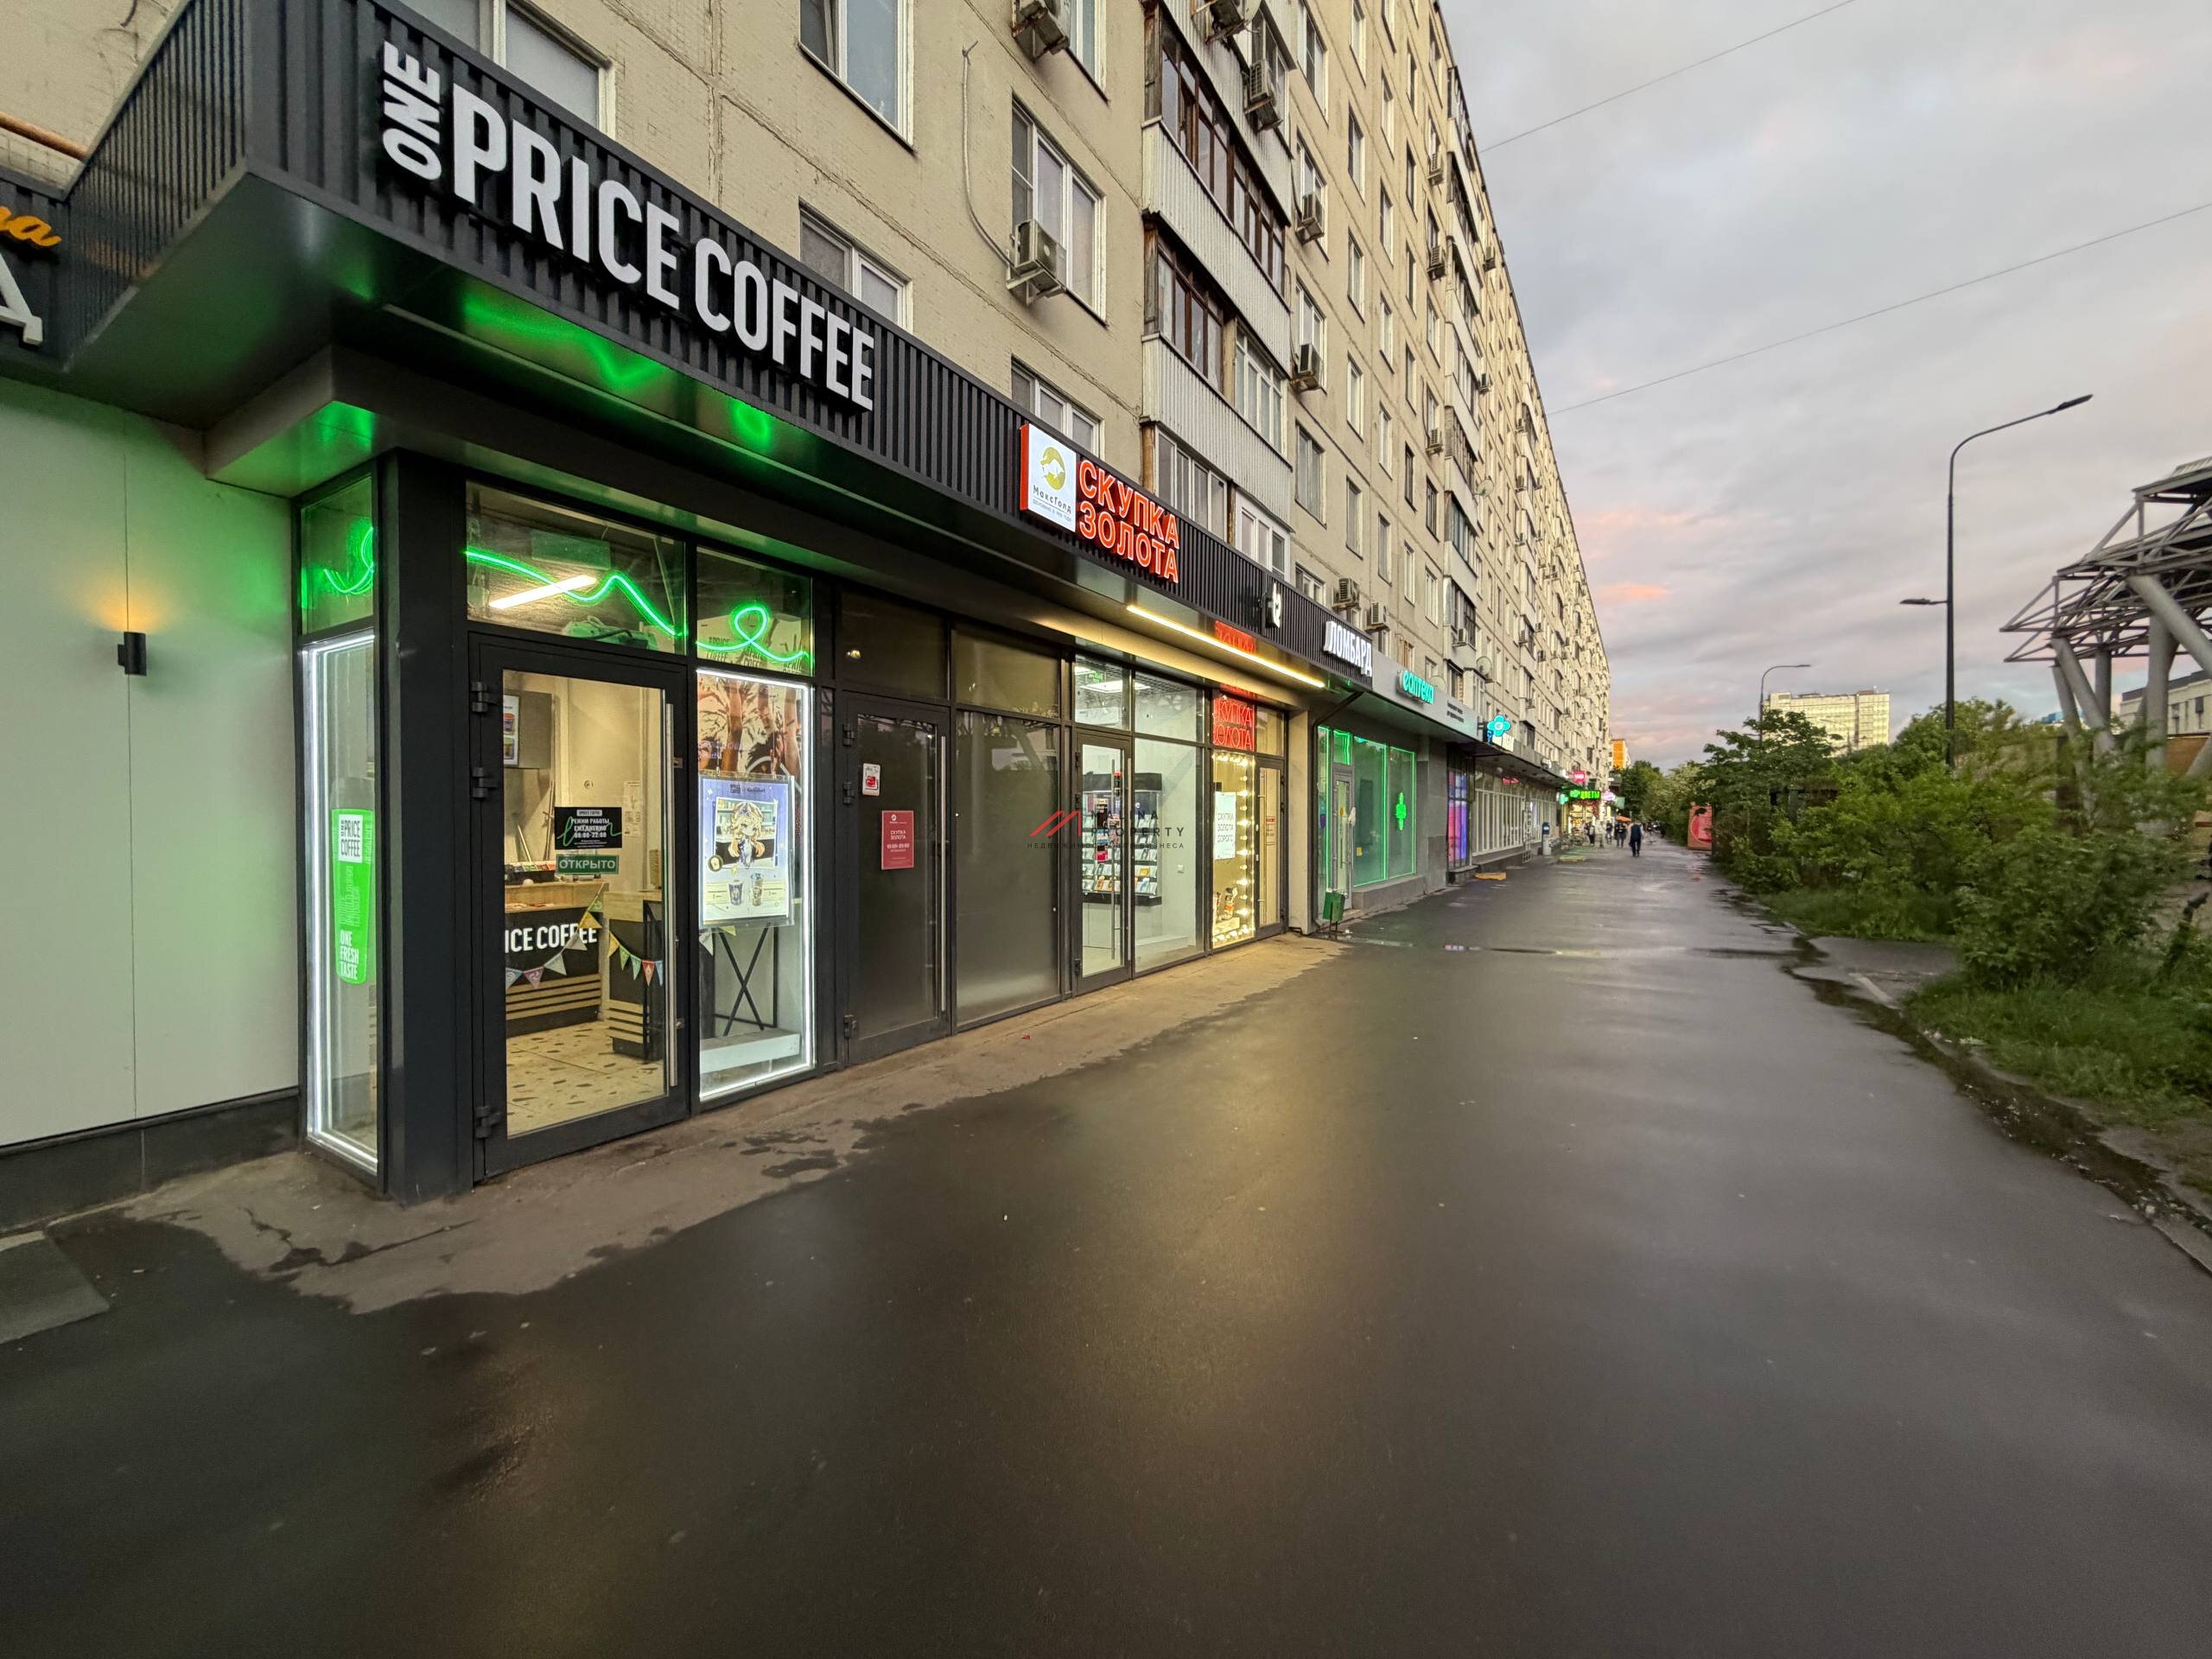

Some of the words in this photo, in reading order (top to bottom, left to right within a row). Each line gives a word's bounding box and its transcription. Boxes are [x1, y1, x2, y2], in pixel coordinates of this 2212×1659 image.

[383, 41, 442, 181] ONE
[453, 83, 680, 310] PRICE
[695, 238, 874, 411] COFFEE
[1033, 484, 1071, 514] МаксГолд
[1079, 460, 1179, 550] СКУПКА
[1079, 500, 1179, 583] ЗОЛОТА
[1324, 620, 1372, 677] ЛОМБАРД
[345, 820, 360, 838] PRICE
[340, 839, 360, 857] COFFEE
[558, 859, 615, 869] ОТКРЫТО
[505, 926, 534, 954] ICE
